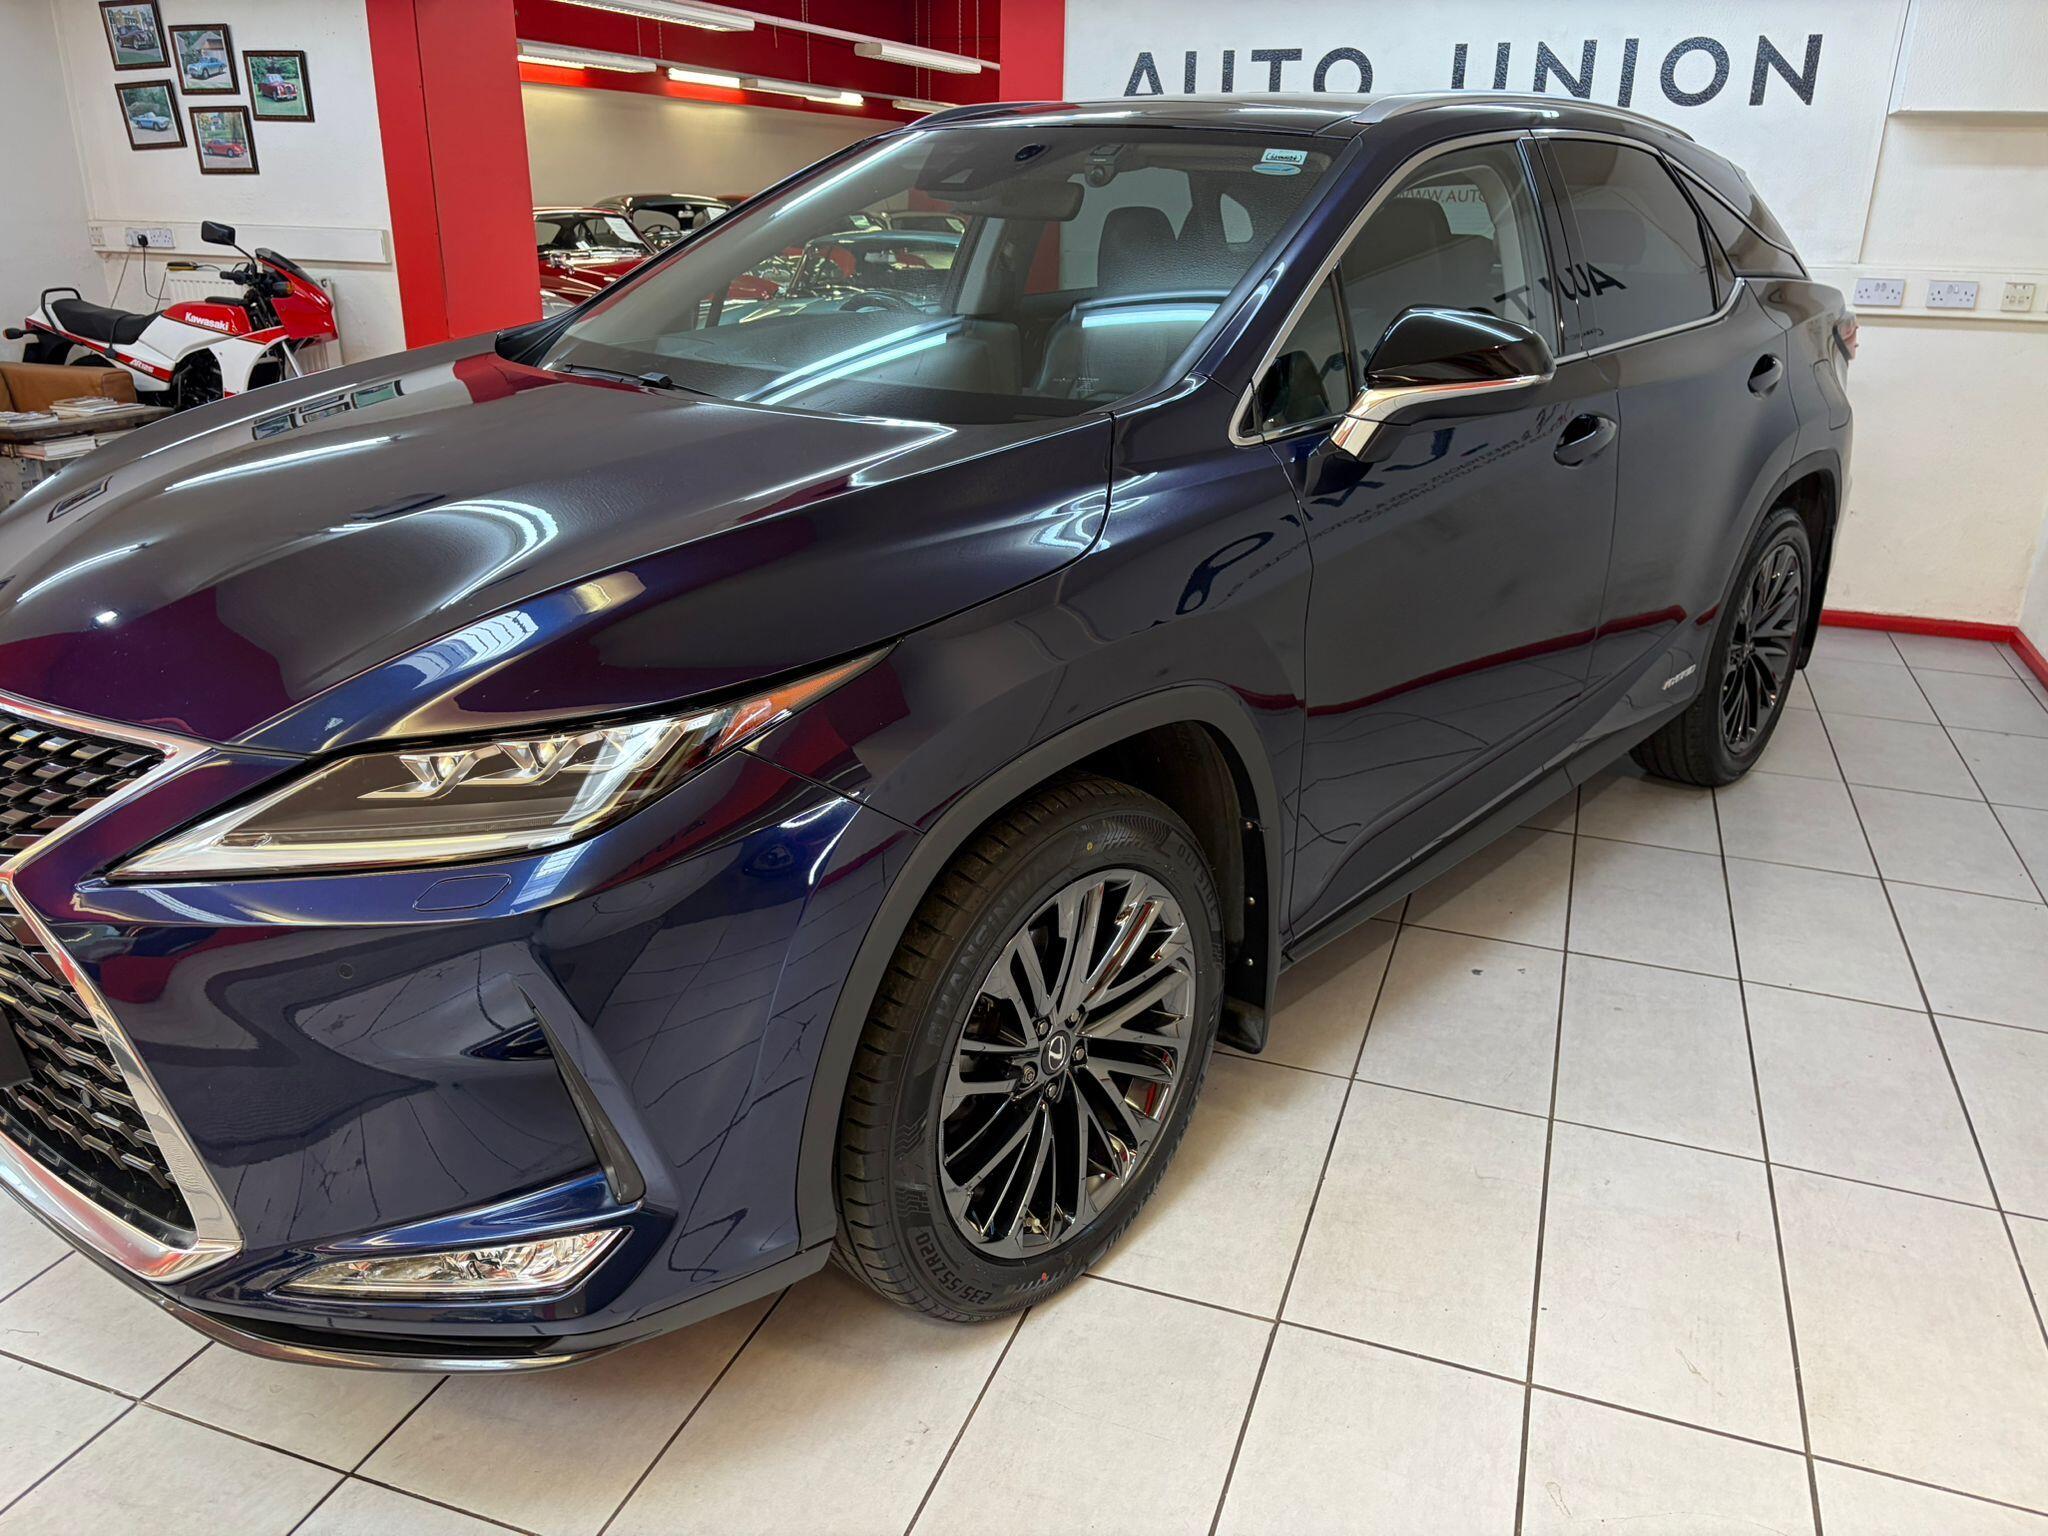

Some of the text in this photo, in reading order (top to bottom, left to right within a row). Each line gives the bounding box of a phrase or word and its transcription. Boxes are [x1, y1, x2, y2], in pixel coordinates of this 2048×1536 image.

[1123, 33, 1824, 107] AUTO UNION
[184, 312, 229, 331] Kawasaki
